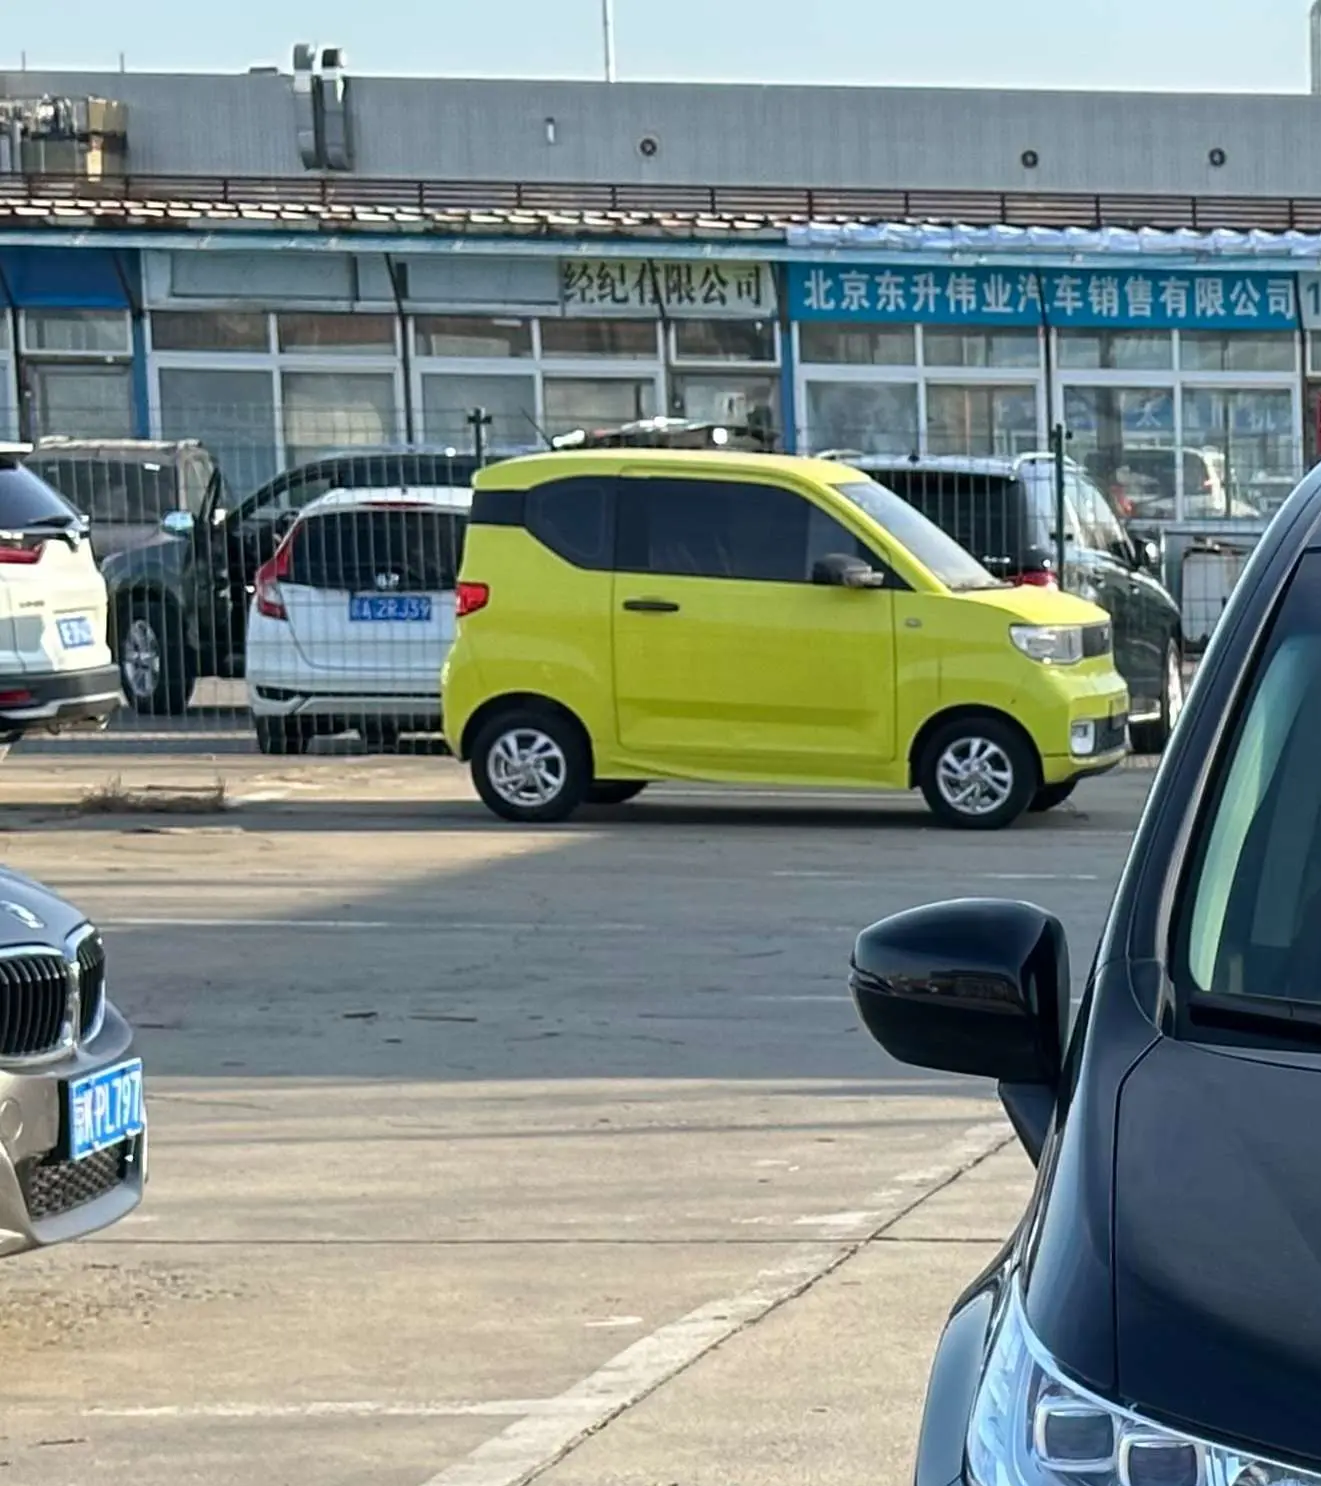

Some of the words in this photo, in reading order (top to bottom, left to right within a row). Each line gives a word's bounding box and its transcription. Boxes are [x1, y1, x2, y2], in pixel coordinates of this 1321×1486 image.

[803, 269, 1297, 320] 北京东升伟业汽车销售有限公司
